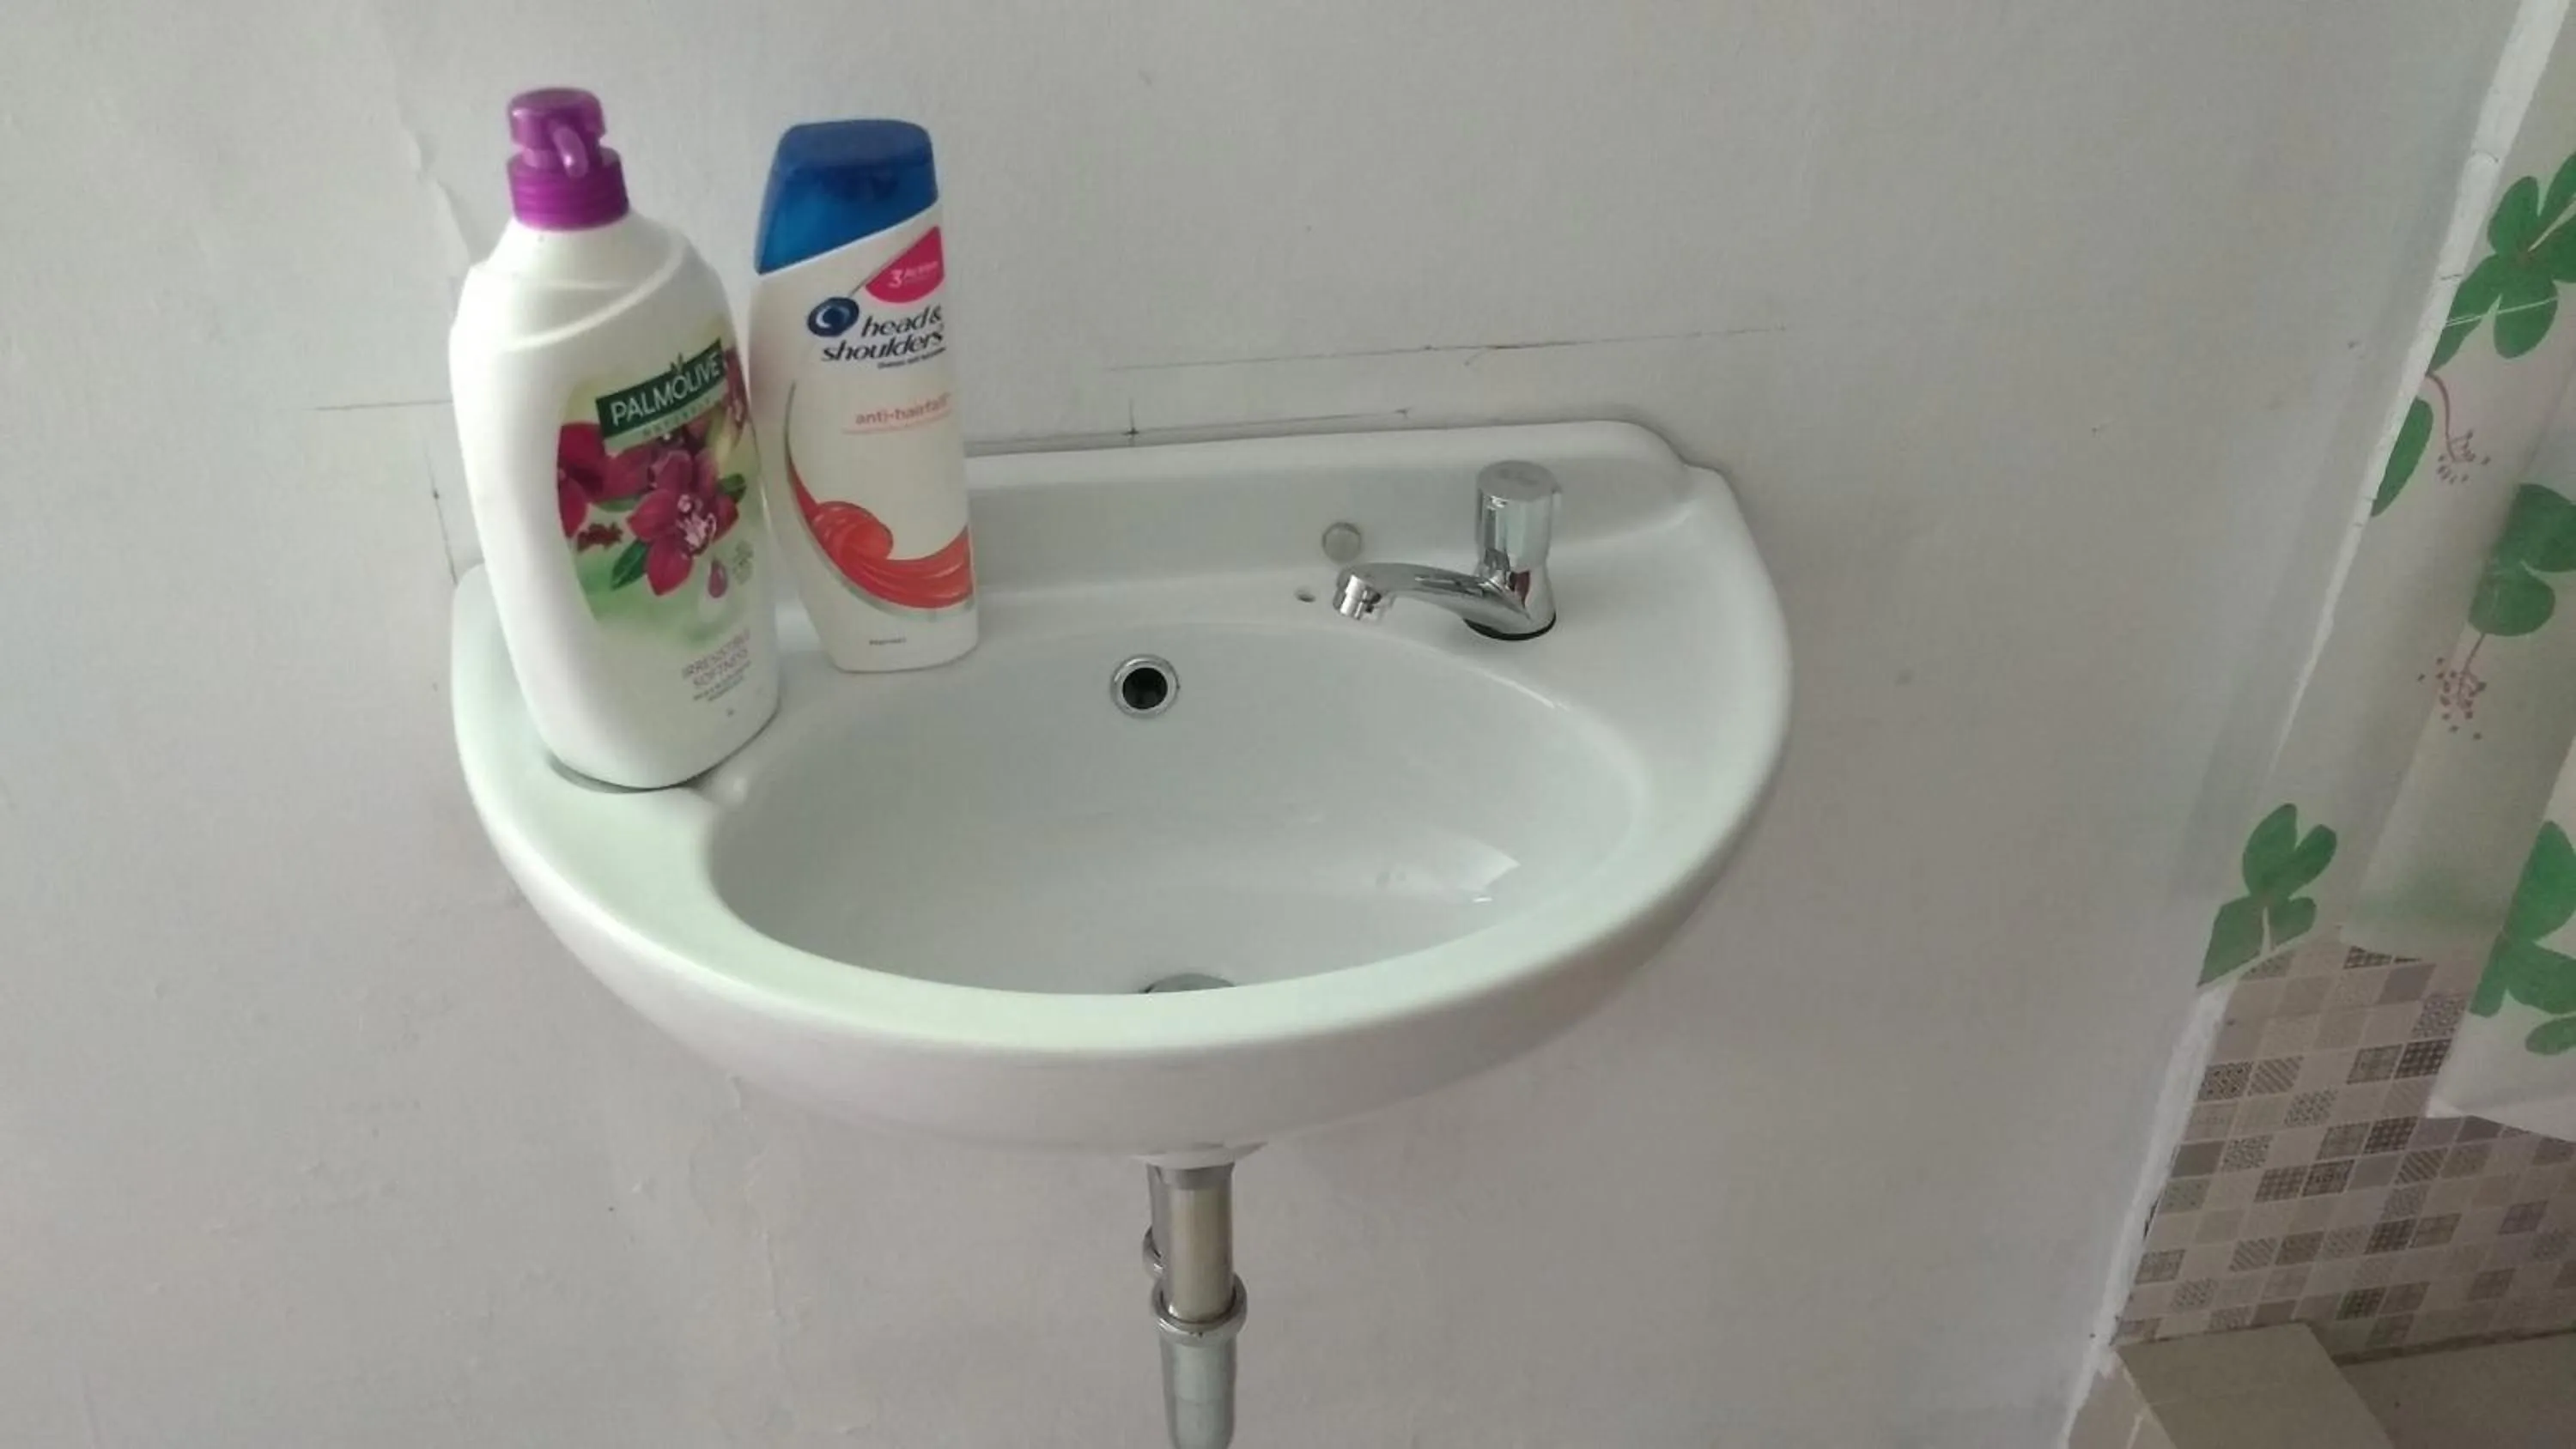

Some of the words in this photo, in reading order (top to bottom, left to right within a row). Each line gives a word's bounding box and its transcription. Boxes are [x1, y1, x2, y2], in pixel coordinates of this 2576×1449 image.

[888, 269, 902, 288] 3
[822, 331, 944, 361] shoulders
[611, 351, 720, 427] PALMOLIVE
